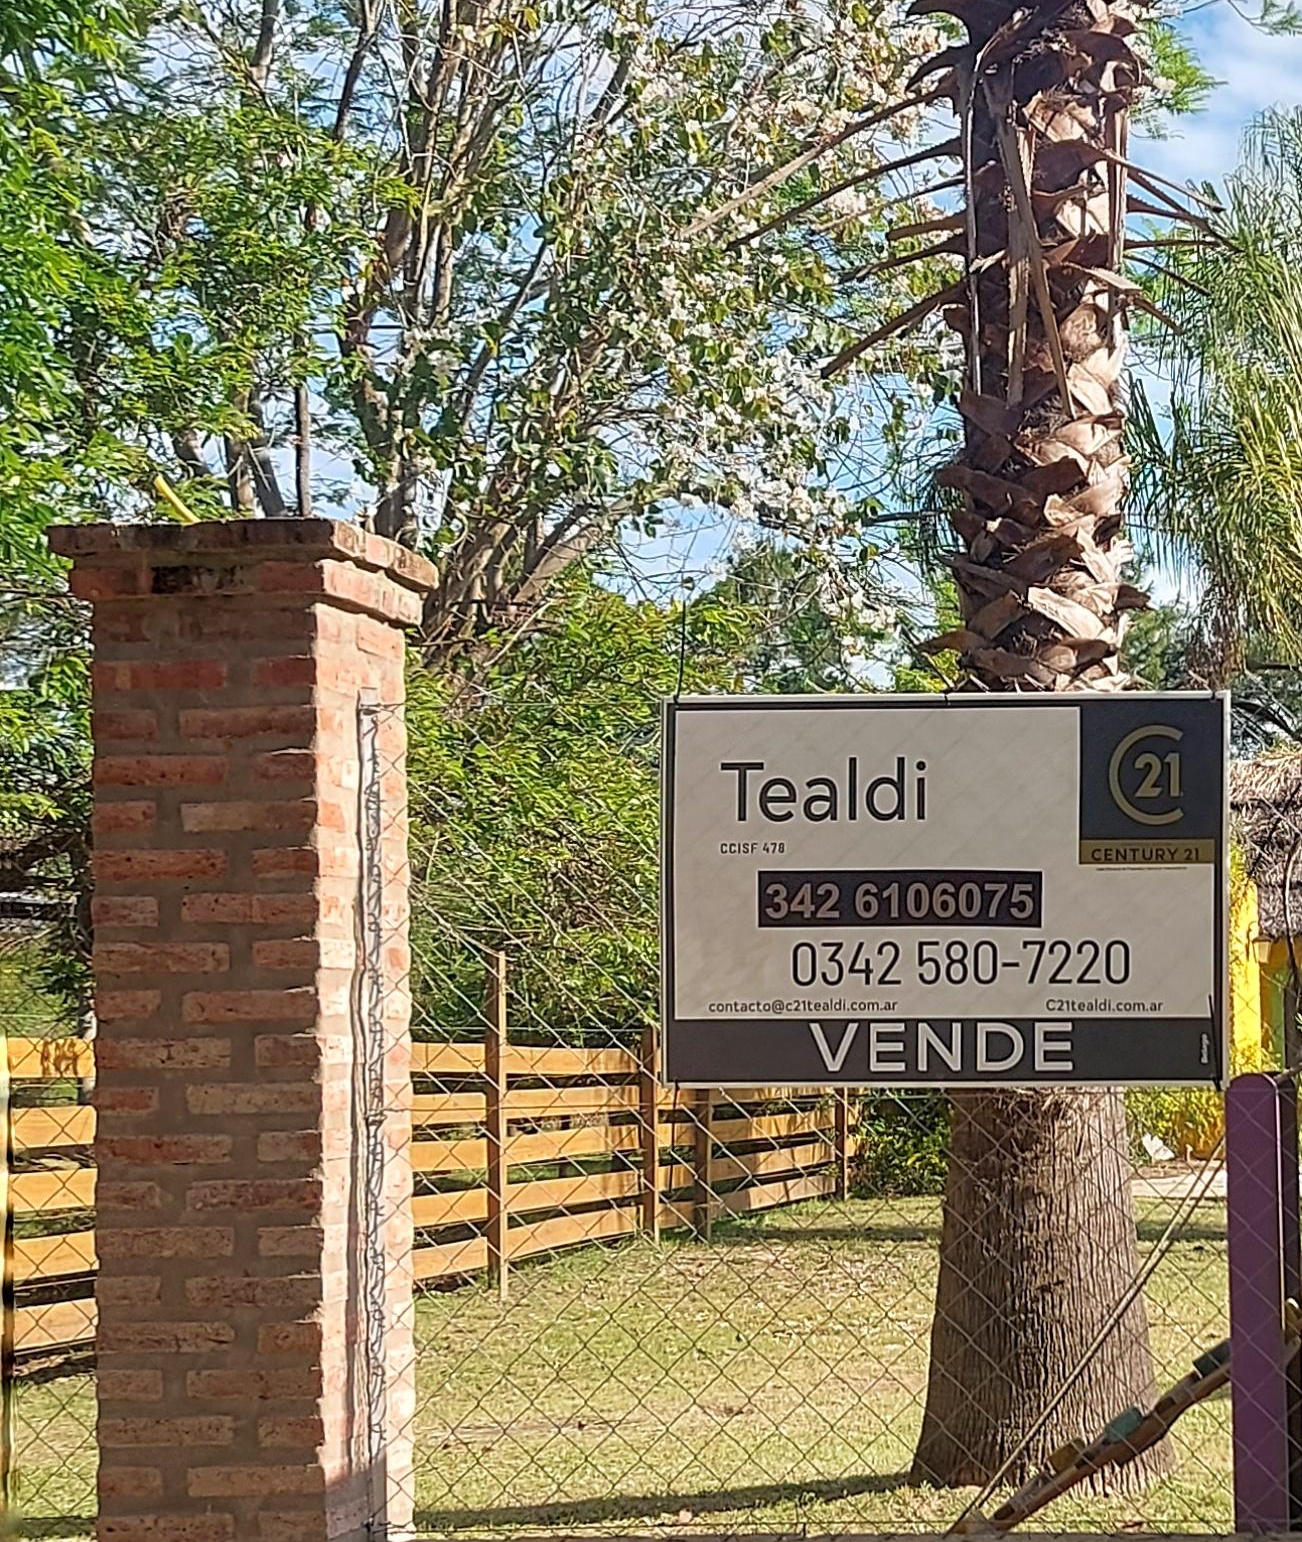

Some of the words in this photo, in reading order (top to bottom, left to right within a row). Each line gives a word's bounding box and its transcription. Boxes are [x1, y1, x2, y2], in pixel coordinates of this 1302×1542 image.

[720, 757, 926, 822] Tealdi
[720, 842, 757, 855] CCISF
[762, 842, 785, 854] 478
[1091, 848, 1178, 862] CENTURY
[1184, 848, 1199, 860] 21
[764, 883, 840, 919] 342
[855, 883, 1034, 919] 6106075
[792, 941, 902, 986] 0342
[917, 939, 1131, 985] 580-7220
[708, 998, 899, 1015] contacto@c21tealdi.com.ar
[1046, 998, 1164, 1013] C21tealdi.com.ar
[809, 1021, 1074, 1072] VENDE
